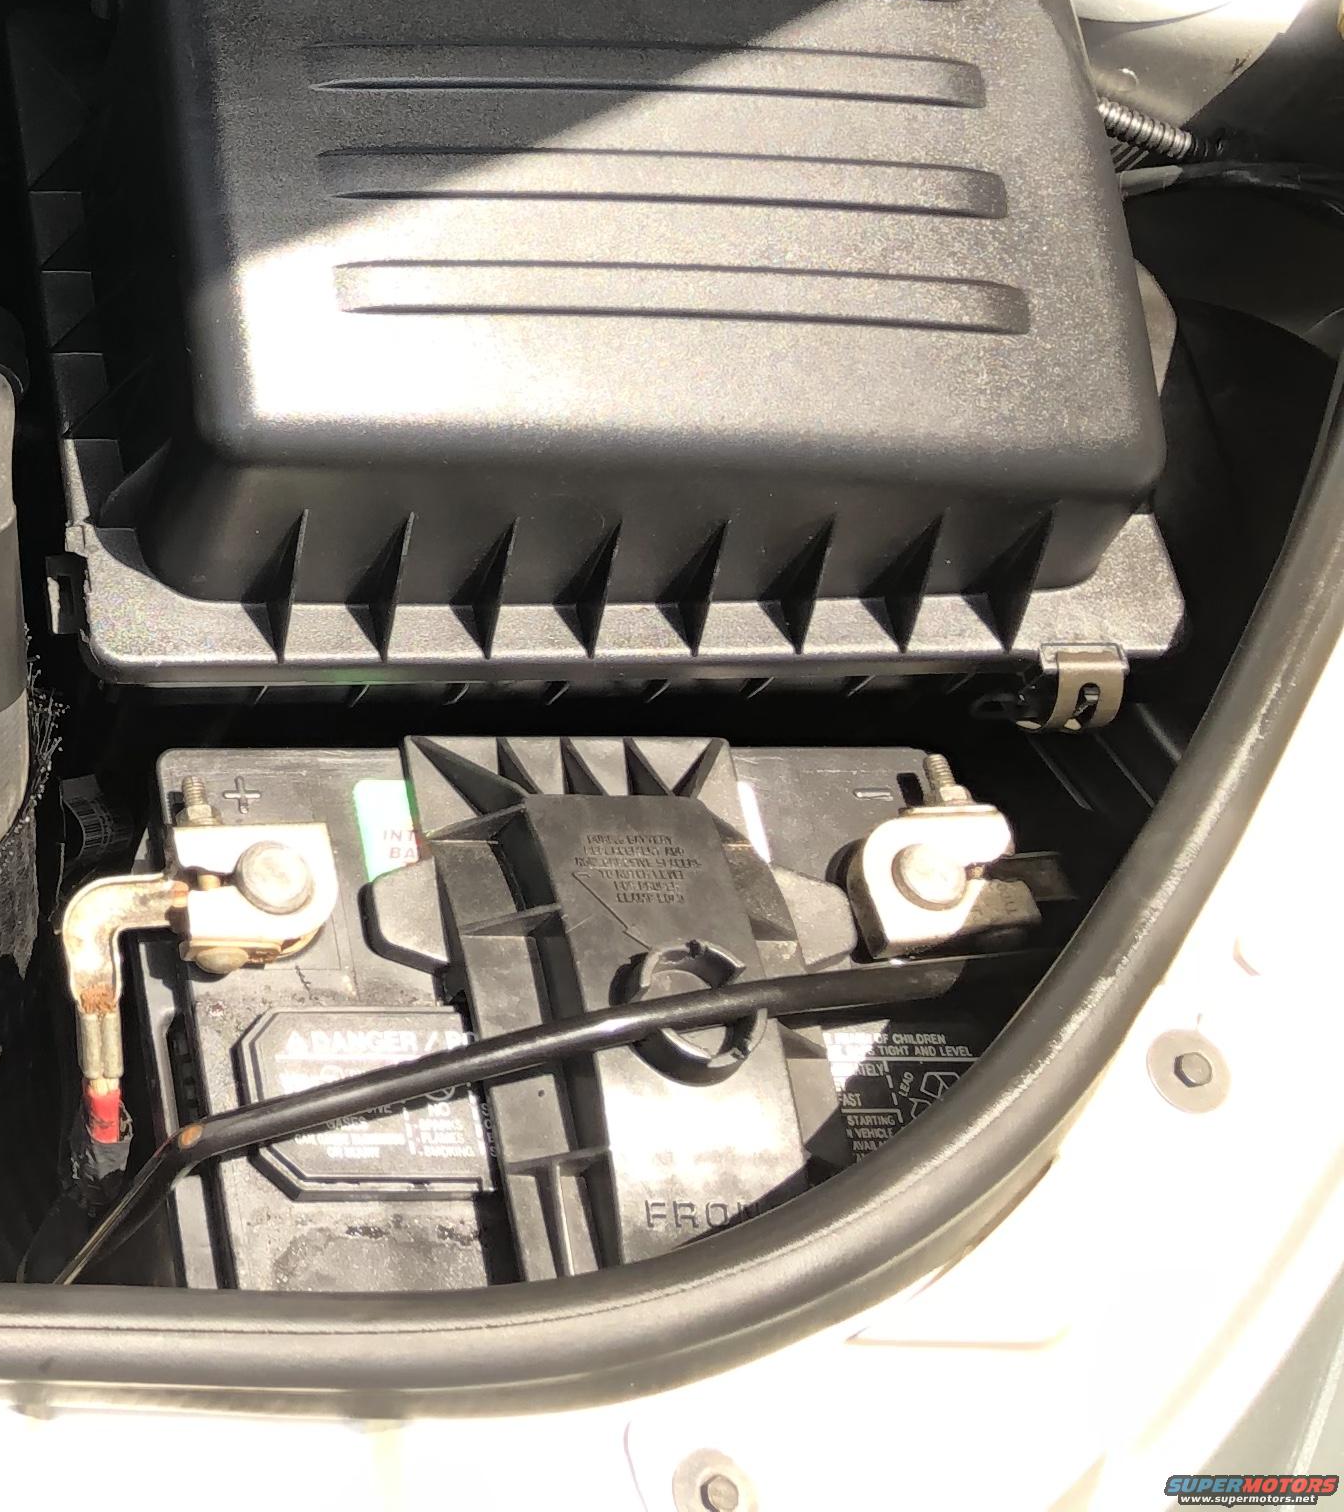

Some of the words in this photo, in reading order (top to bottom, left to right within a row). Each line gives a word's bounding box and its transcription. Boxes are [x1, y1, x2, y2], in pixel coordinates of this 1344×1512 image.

[310, 1030, 418, 1053] DANGER
[892, 1033, 947, 1045] CHILDREN
[879, 1045, 910, 1056] TIGHT
[914, 1045, 937, 1057] AND
[939, 1045, 973, 1057] LEVEL
[898, 1071, 914, 1098] LEAD
[428, 1102, 451, 1117] NO
[847, 1115, 896, 1127] STARTING
[856, 1128, 894, 1139] VEHICLE
[424, 1145, 476, 1158] SMOKING
